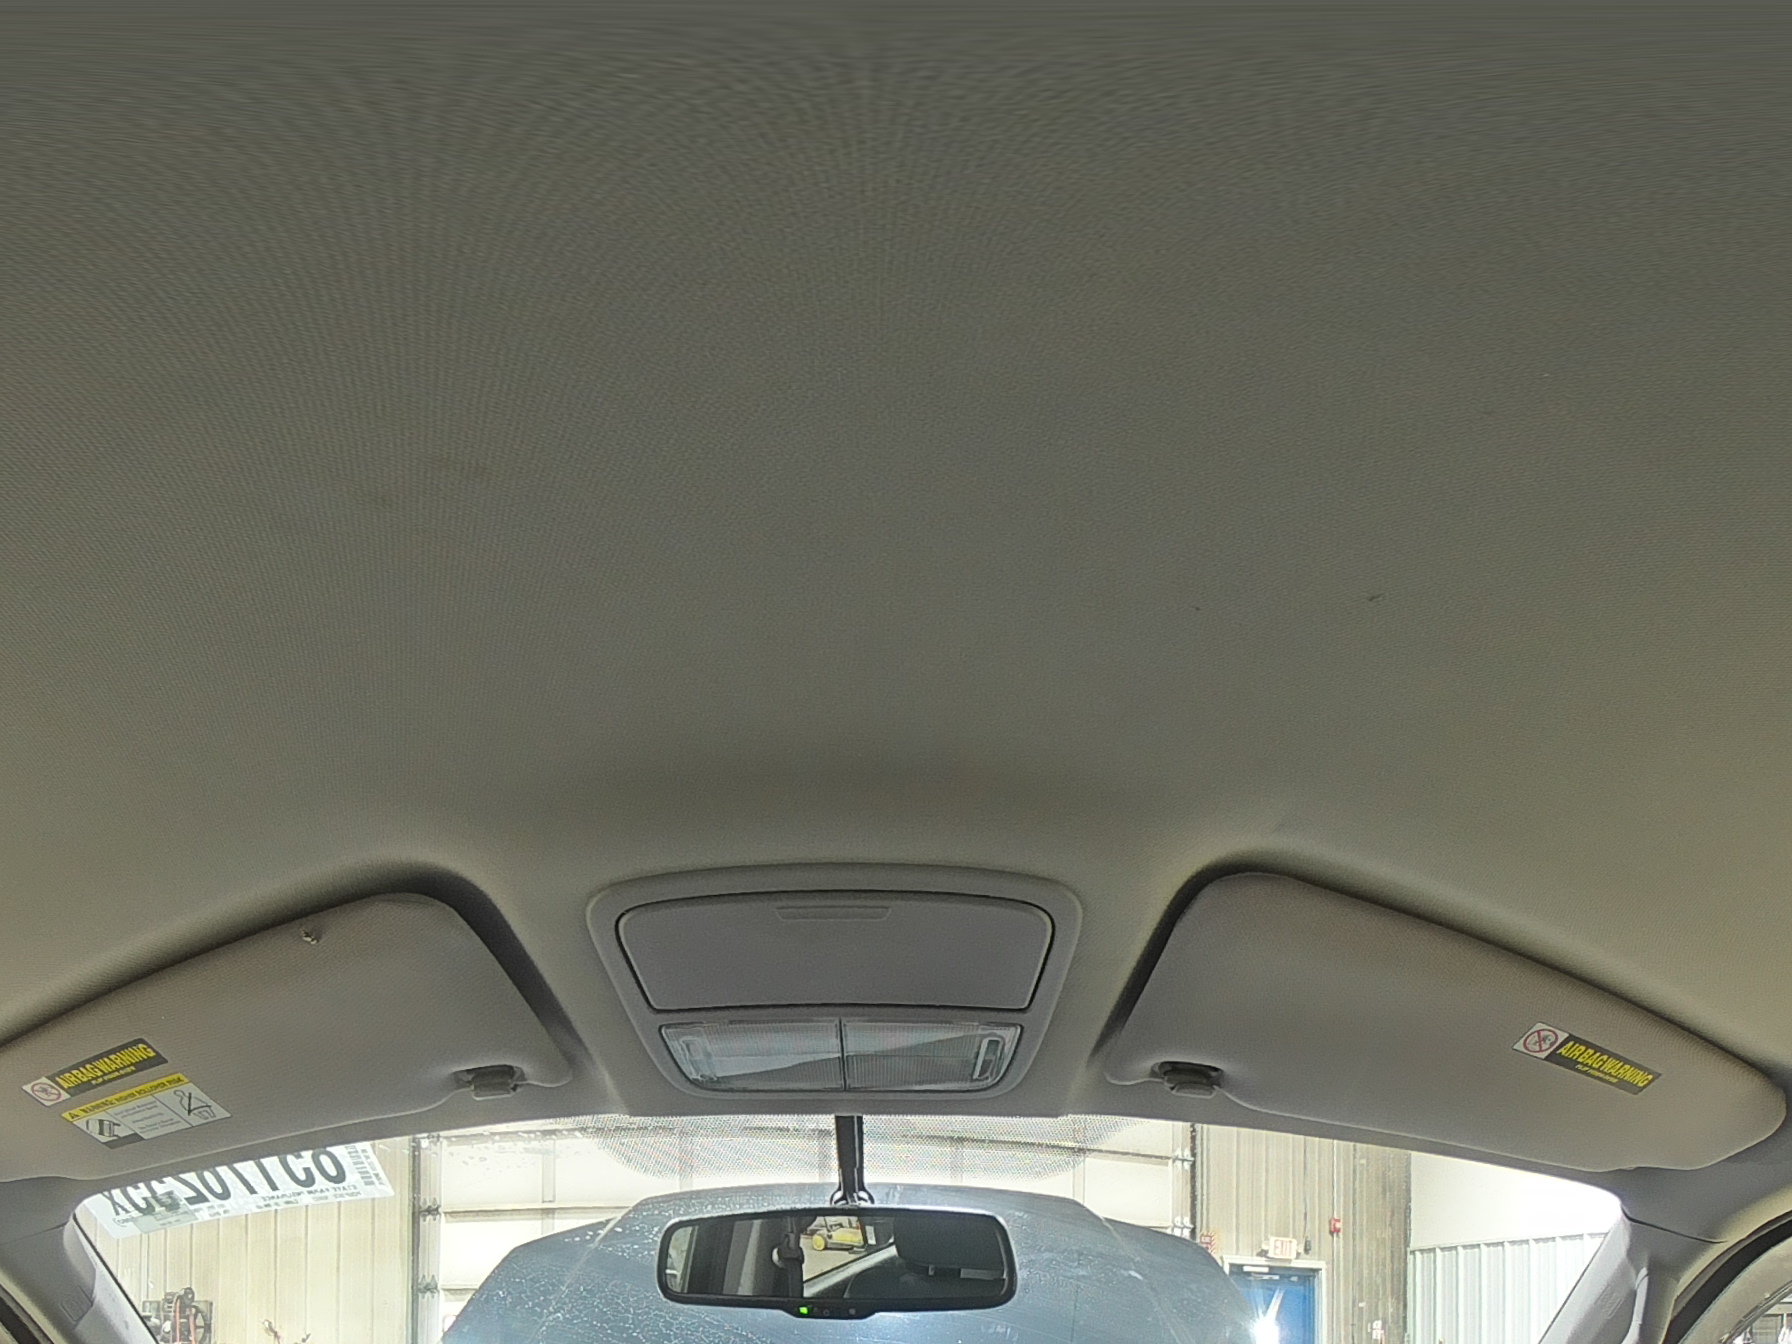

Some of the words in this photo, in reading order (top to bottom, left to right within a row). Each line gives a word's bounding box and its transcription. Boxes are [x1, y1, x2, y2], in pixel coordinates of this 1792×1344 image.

[55, 1063, 101, 1089] AIRBAG
[95, 1043, 157, 1074] WARNING
[1557, 1041, 1604, 1070] AIRBAG
[1600, 1057, 1654, 1087] WARNING
[1273, 1238, 1293, 1257] EXIT
